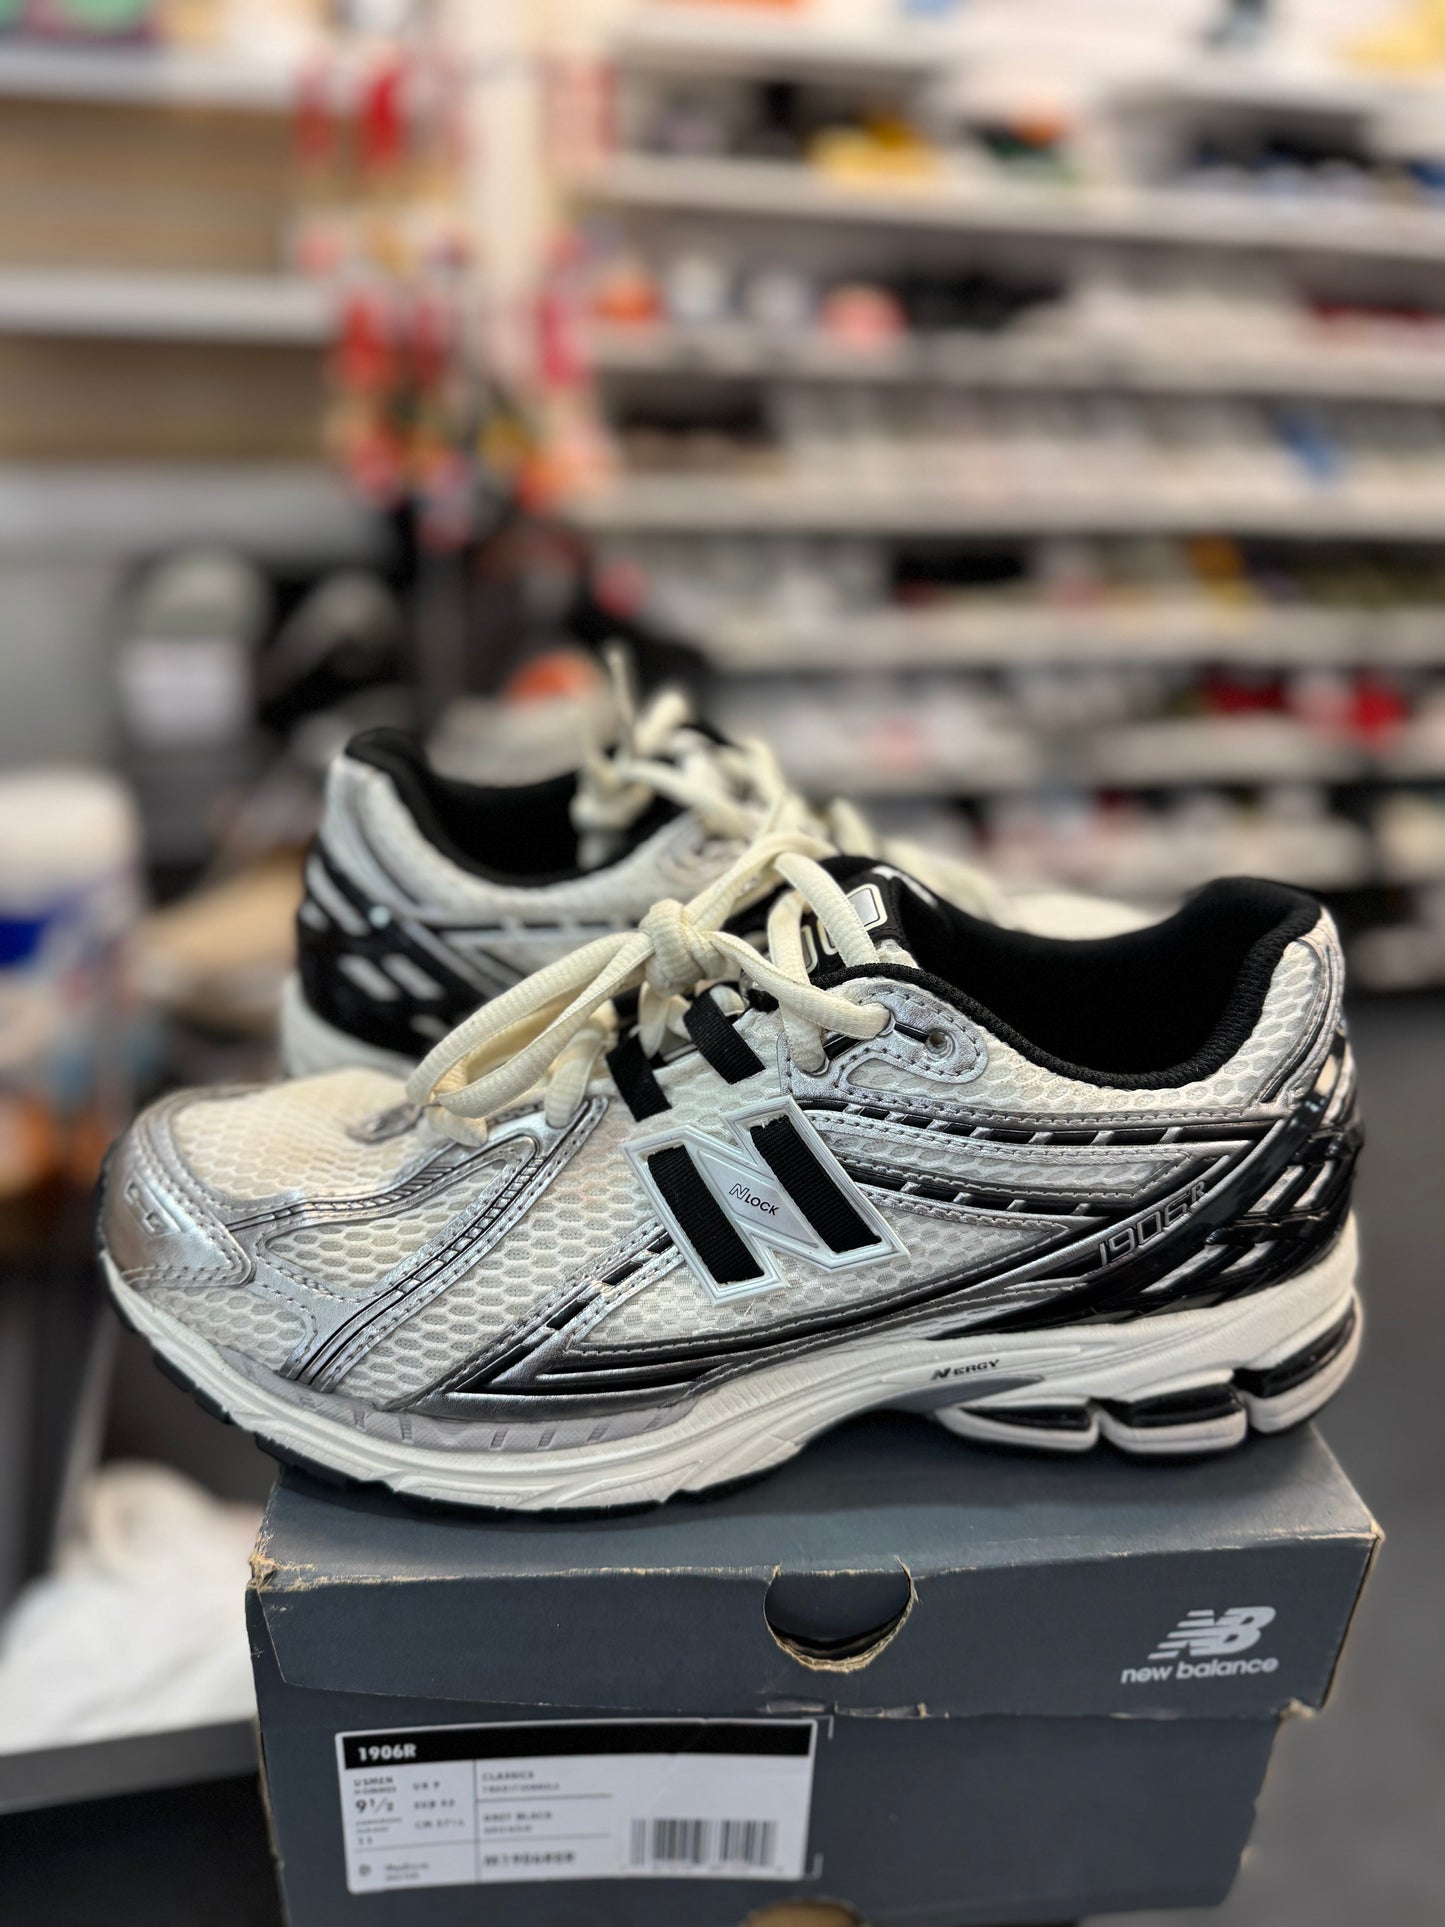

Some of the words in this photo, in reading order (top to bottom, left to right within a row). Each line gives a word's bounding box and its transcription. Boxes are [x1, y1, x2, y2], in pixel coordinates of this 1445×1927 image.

[728, 1182, 779, 1216] NLOCK
[1099, 1181, 1206, 1266] 1906R
[930, 1359, 1000, 1380] NERGY
[1120, 1665, 1172, 1684] new
[1175, 1657, 1279, 1680] balance
[358, 1743, 417, 1761] 1906R
